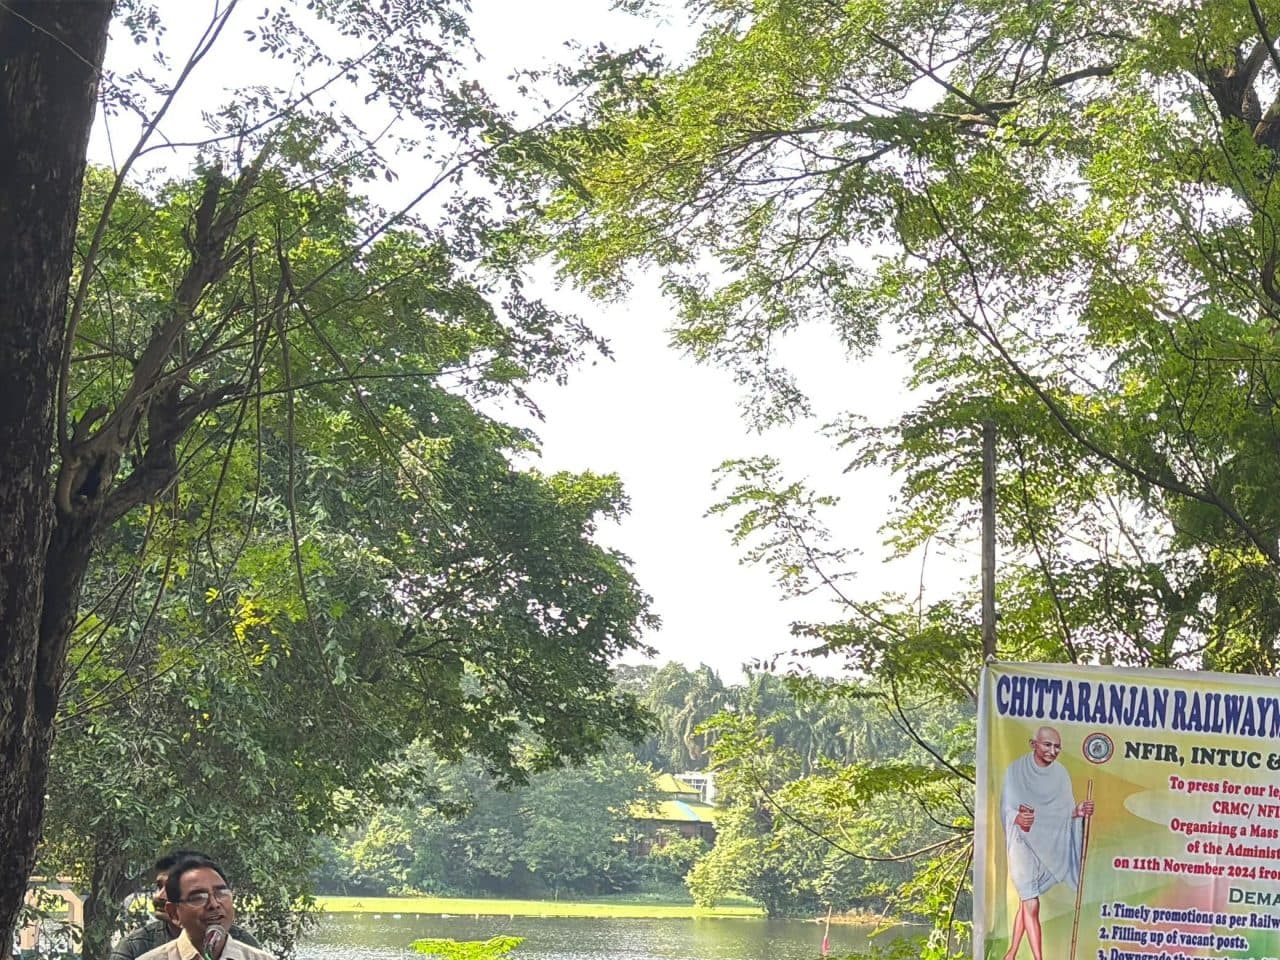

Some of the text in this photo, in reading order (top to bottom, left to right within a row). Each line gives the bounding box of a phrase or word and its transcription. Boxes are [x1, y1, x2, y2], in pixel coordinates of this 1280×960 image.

[997, 675, 1168, 728] CHITTARANJAN
[1125, 741, 1184, 767] NFIR,
[1191, 747, 1261, 768] INTUC
[1170, 776, 1184, 790] To
[1188, 781, 1219, 793] press
[1222, 780, 1241, 795] for
[1244, 784, 1265, 796] our
[1213, 801, 1254, 819] CRMC/
[1171, 818, 1237, 838] Organizing
[1240, 827, 1247, 836] a
[1250, 824, 1278, 839] Mass
[1187, 841, 1200, 853] of
[1203, 842, 1222, 855] the
[1114, 859, 1129, 869] on
[1134, 858, 1160, 871] 11th
[1163, 858, 1225, 876] November
[1228, 866, 1256, 880] 2024
[1101, 905, 1110, 916] 1.
[1114, 903, 1150, 922] Timely
[1153, 909, 1213, 924] promotions
[1216, 916, 1226, 925] as
[1230, 916, 1248, 928] per
[1099, 926, 1248, 950] 2. Filling up of vacant posts.
